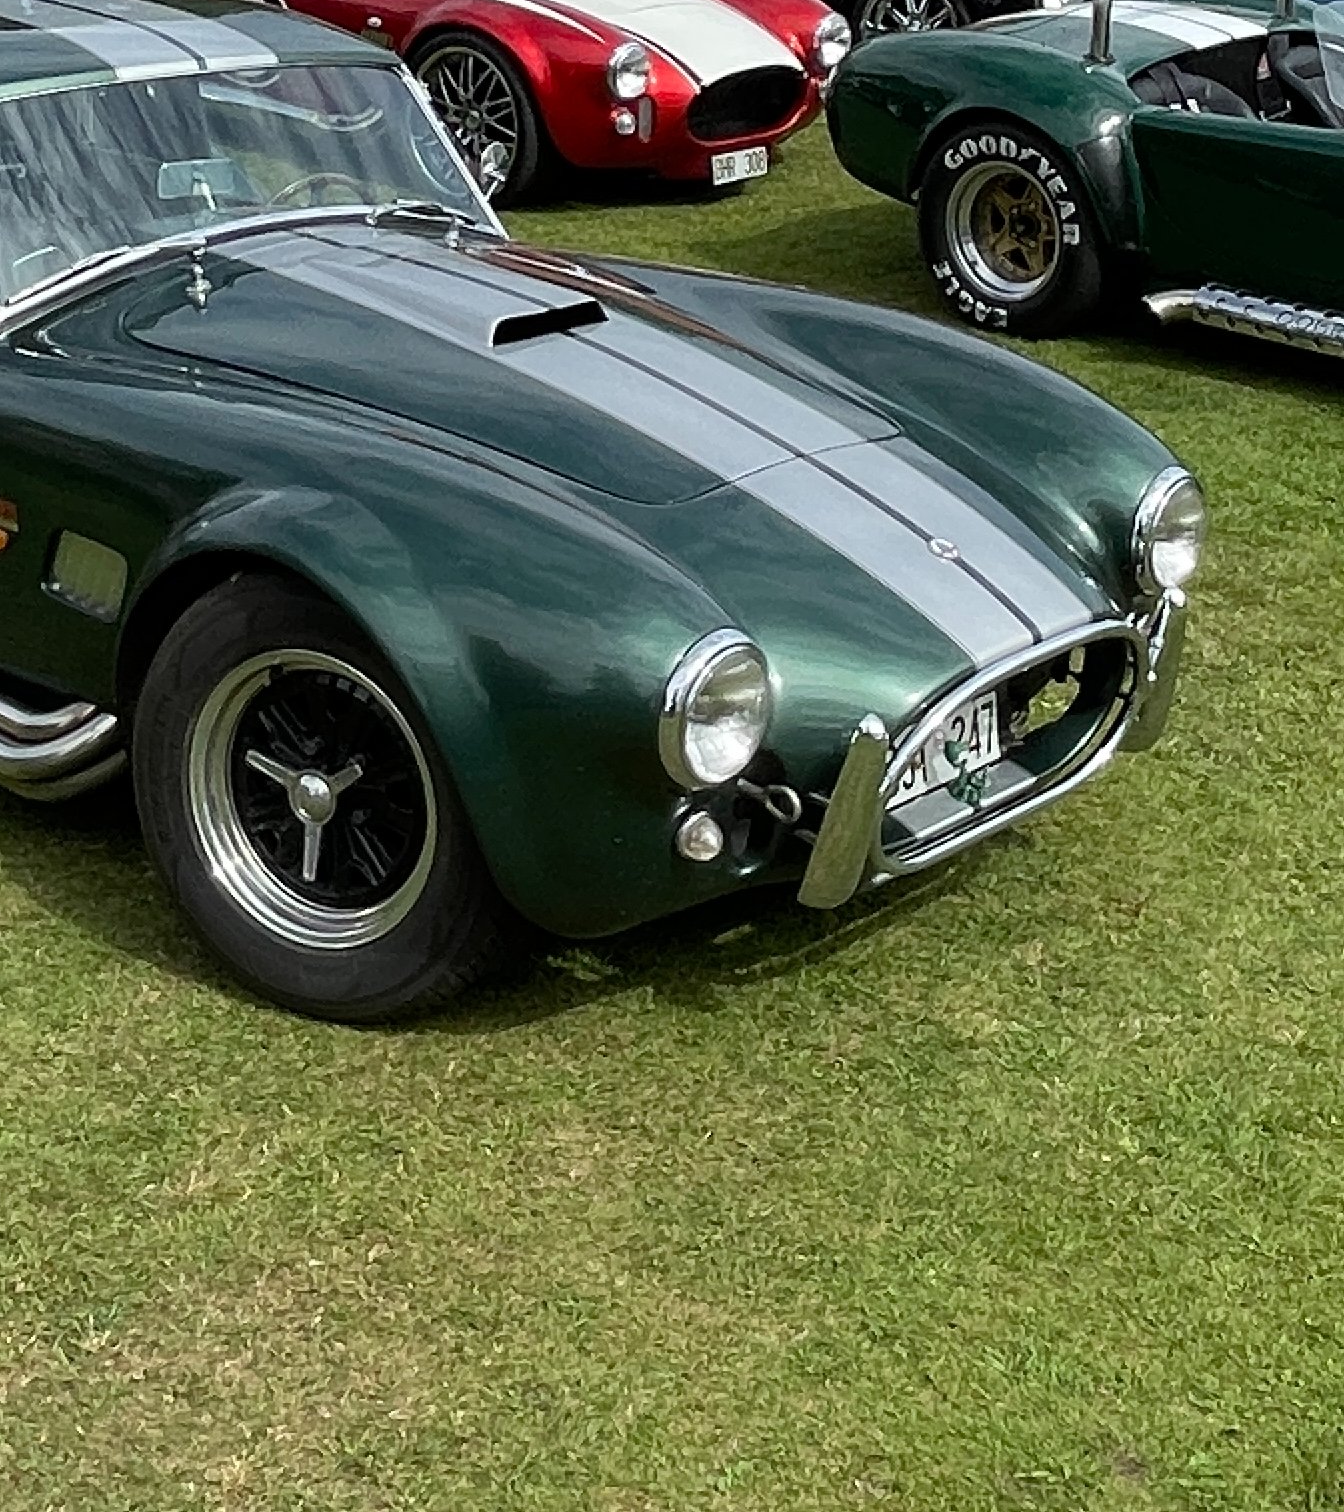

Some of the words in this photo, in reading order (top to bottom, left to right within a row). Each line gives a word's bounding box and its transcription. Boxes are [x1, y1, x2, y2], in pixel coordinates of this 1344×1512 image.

[943, 134, 1081, 246] GOODYEAR
[932, 258, 1009, 328] EAGLE
[951, 700, 995, 760] 247
